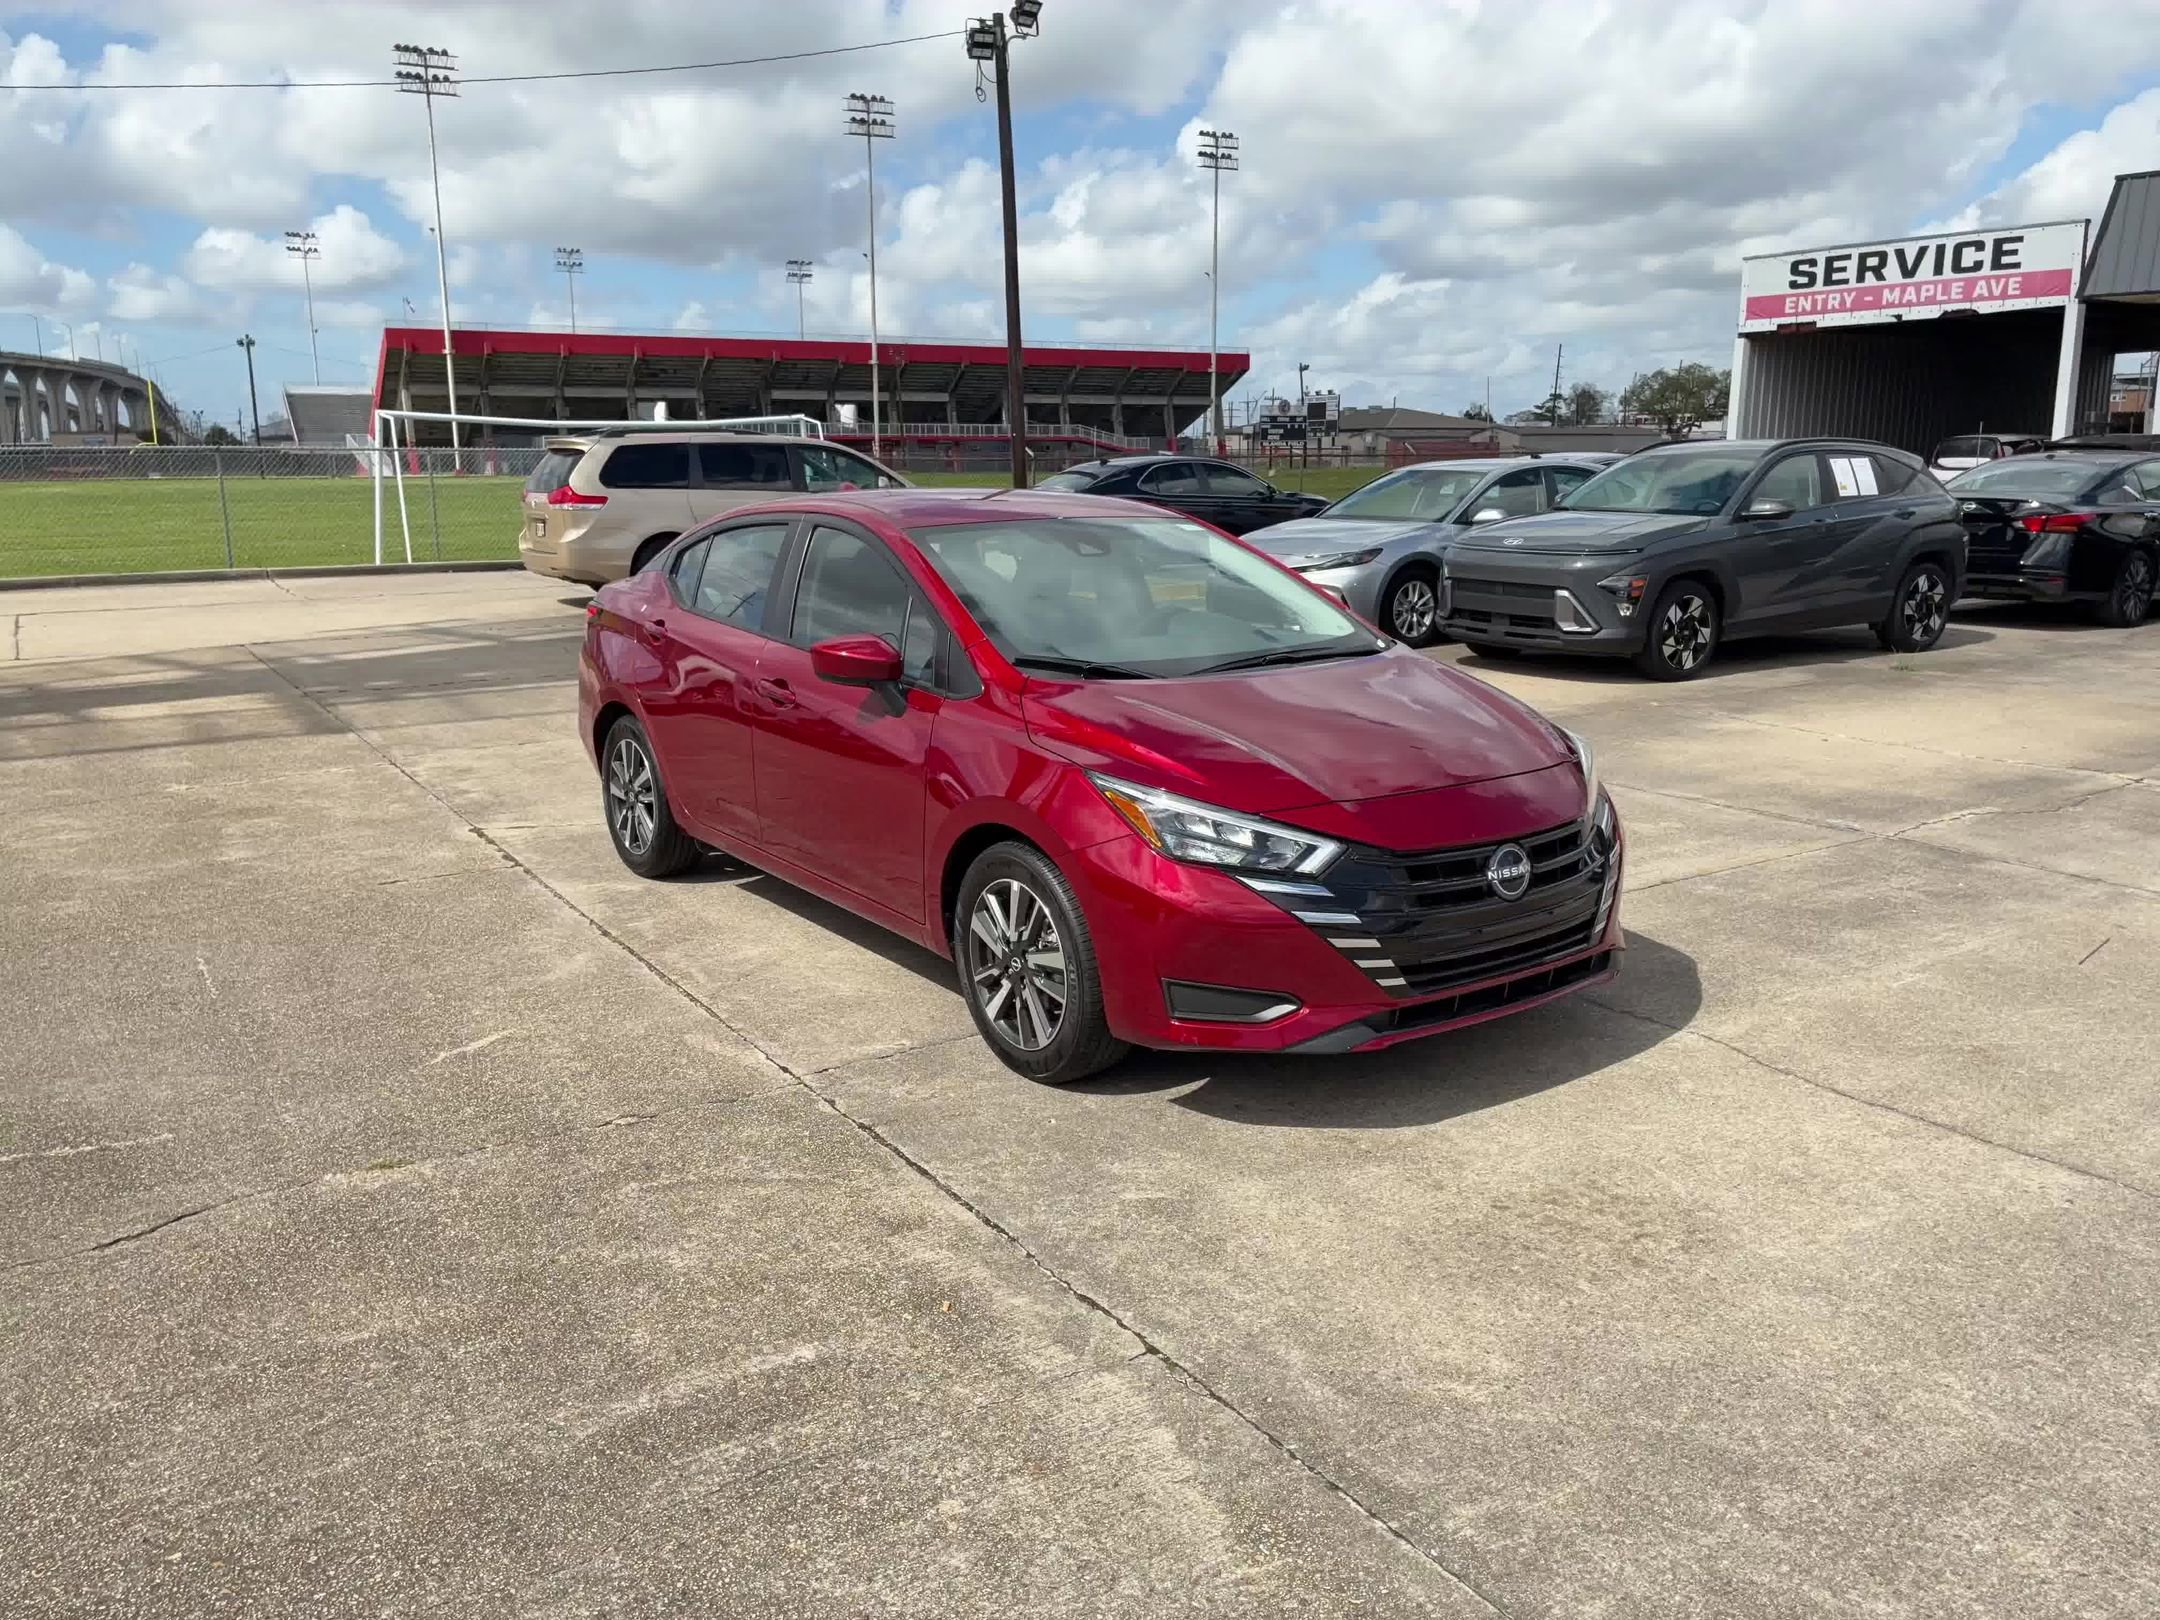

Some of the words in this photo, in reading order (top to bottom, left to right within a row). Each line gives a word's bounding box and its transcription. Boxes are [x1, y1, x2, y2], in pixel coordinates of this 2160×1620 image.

[1788, 235, 2024, 290] SERVICE
[1784, 291, 1857, 314] ENTRY
[1881, 281, 1965, 306] MAPLE
[1972, 276, 2023, 298] AVE
[1487, 864, 1530, 880] NISSAN
